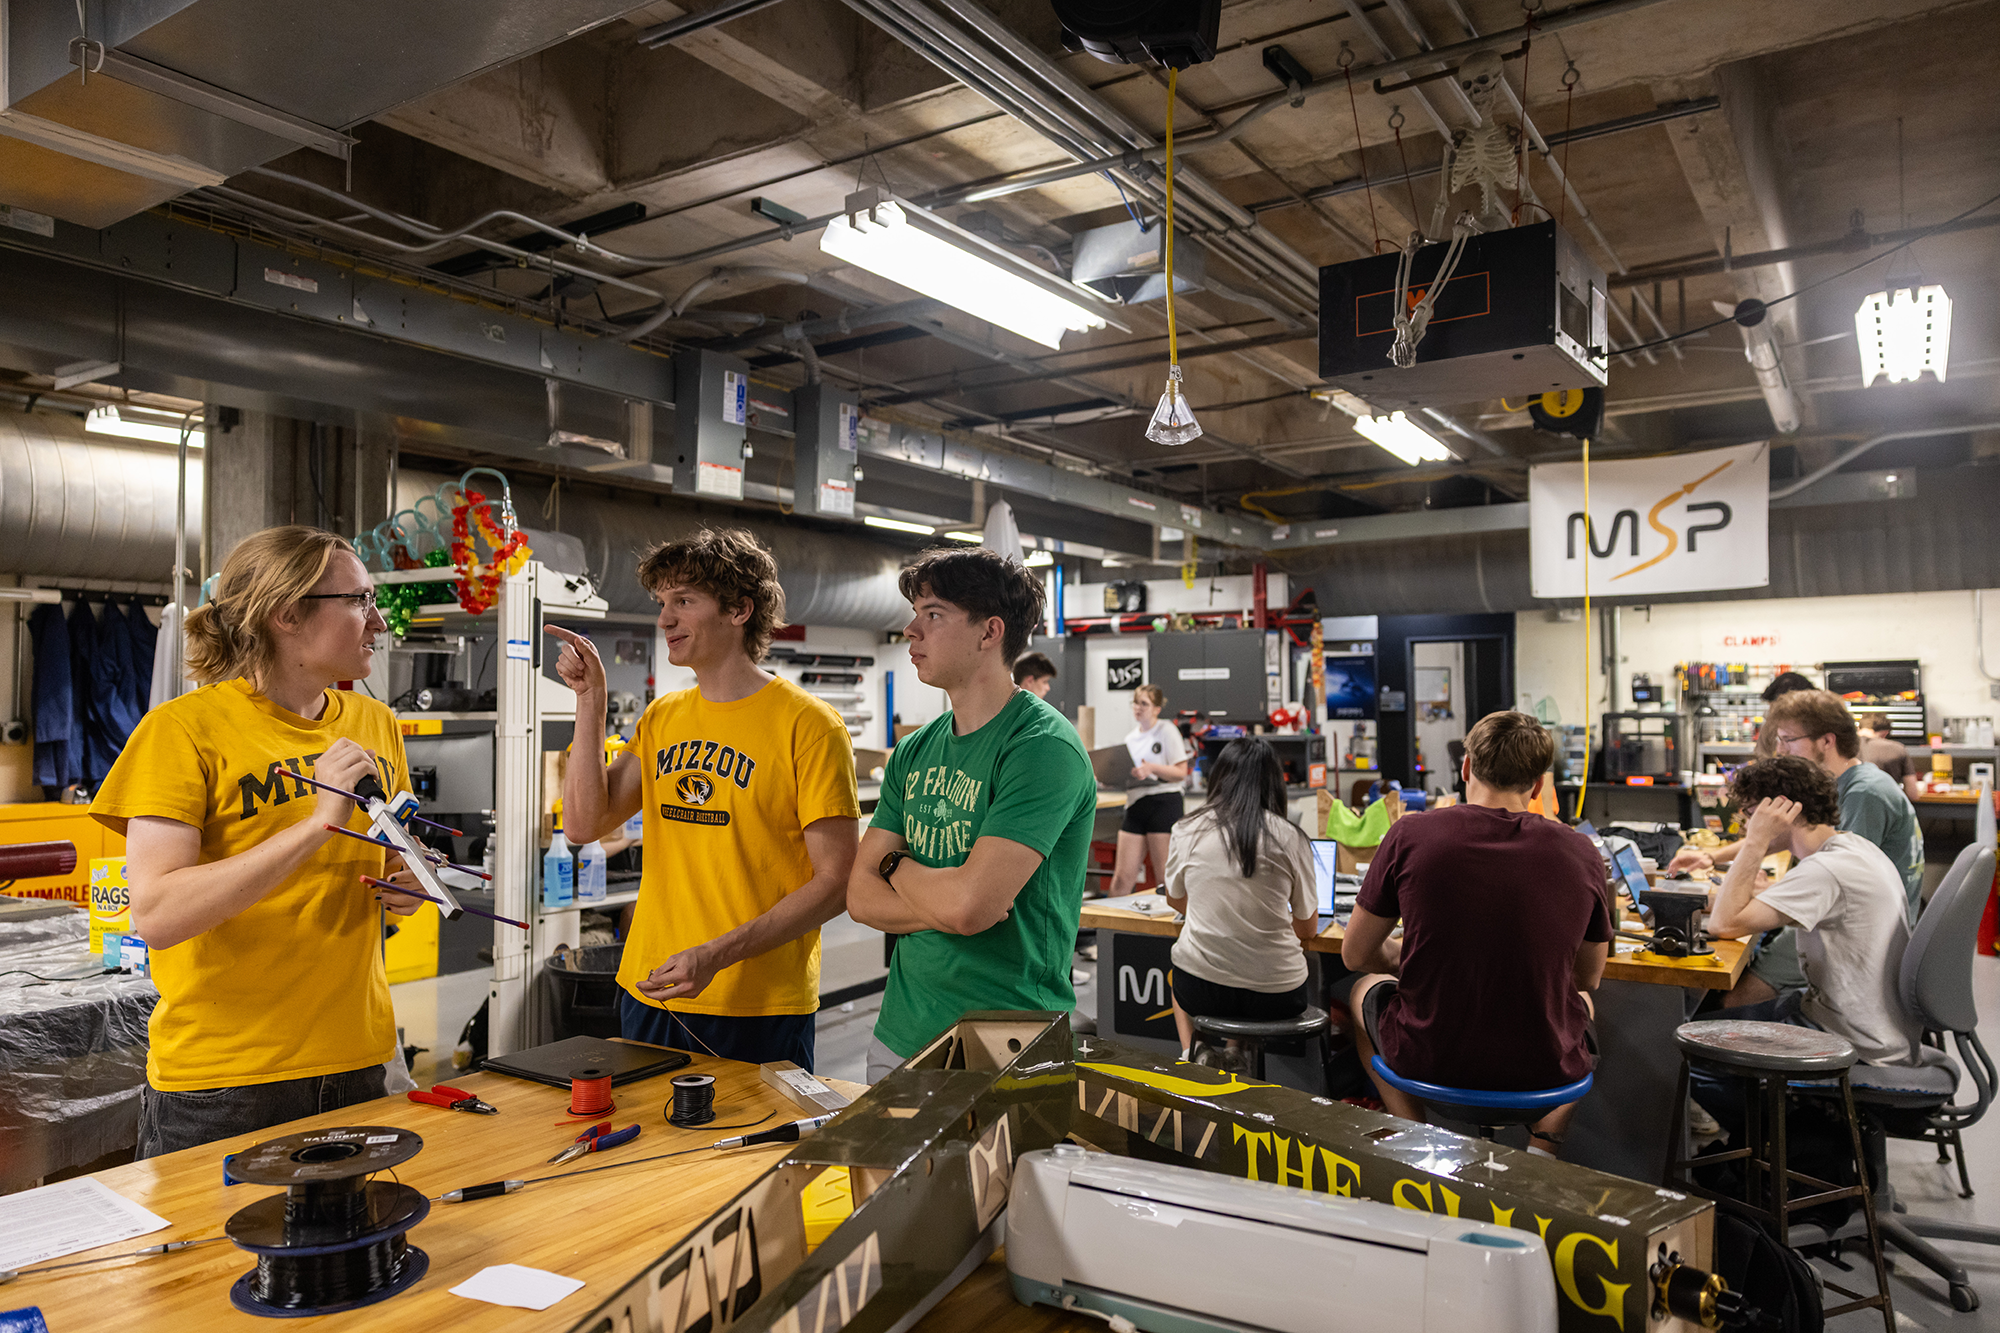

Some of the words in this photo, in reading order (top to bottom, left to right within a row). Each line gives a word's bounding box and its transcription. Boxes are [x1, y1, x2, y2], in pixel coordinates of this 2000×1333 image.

[1567, 488, 1734, 581] MSP
[656, 740, 756, 789] MIZZOU
[662, 806, 695, 821] HEELCHAIR
[919, 803, 932, 814] EST
[91, 886, 130, 905] RAGS
[1232, 1121, 1362, 1203] THE
[1391, 1178, 1632, 1332] SG
